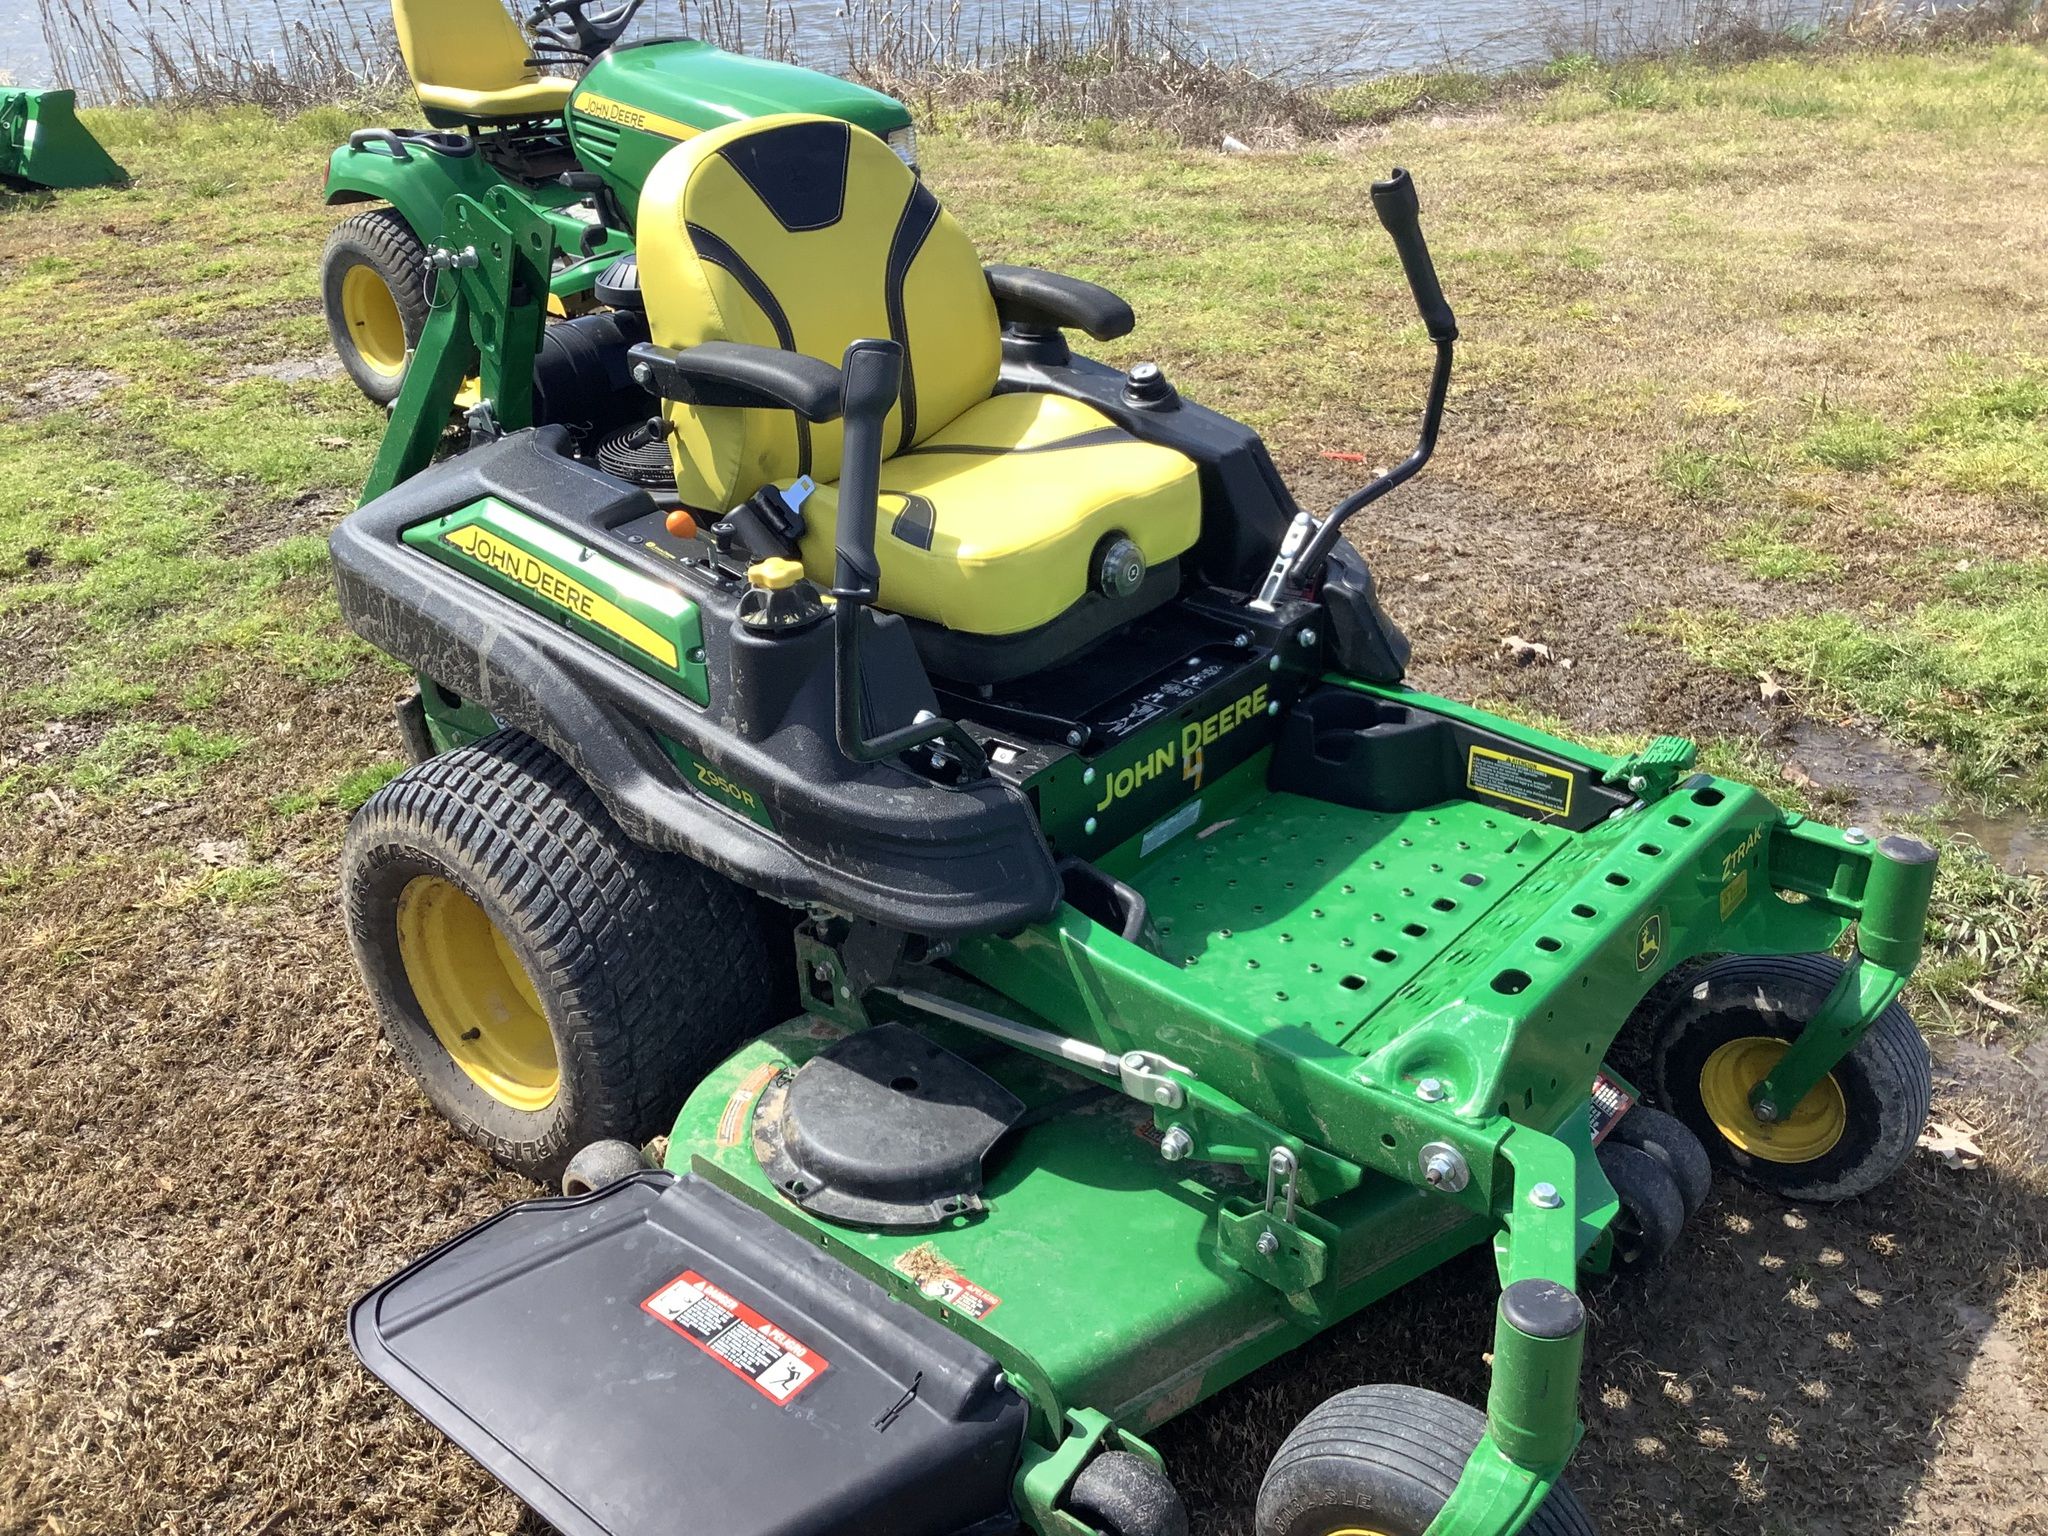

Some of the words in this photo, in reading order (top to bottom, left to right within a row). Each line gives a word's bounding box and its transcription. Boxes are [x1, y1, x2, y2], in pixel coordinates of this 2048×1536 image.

[585, 98, 610, 117] JOHN
[611, 104, 646, 127] DEERE
[465, 530, 521, 577] JOHN
[524, 560, 594, 617] DEERE
[1097, 741, 1175, 812] JOHN
[1181, 684, 1268, 756] DEERE
[692, 761, 755, 809] Z950R
[1721, 823, 1762, 882] ZTRAK
[459, 1107, 570, 1162] CARLISLE
[1272, 1487, 1374, 1536] CARLISLE
